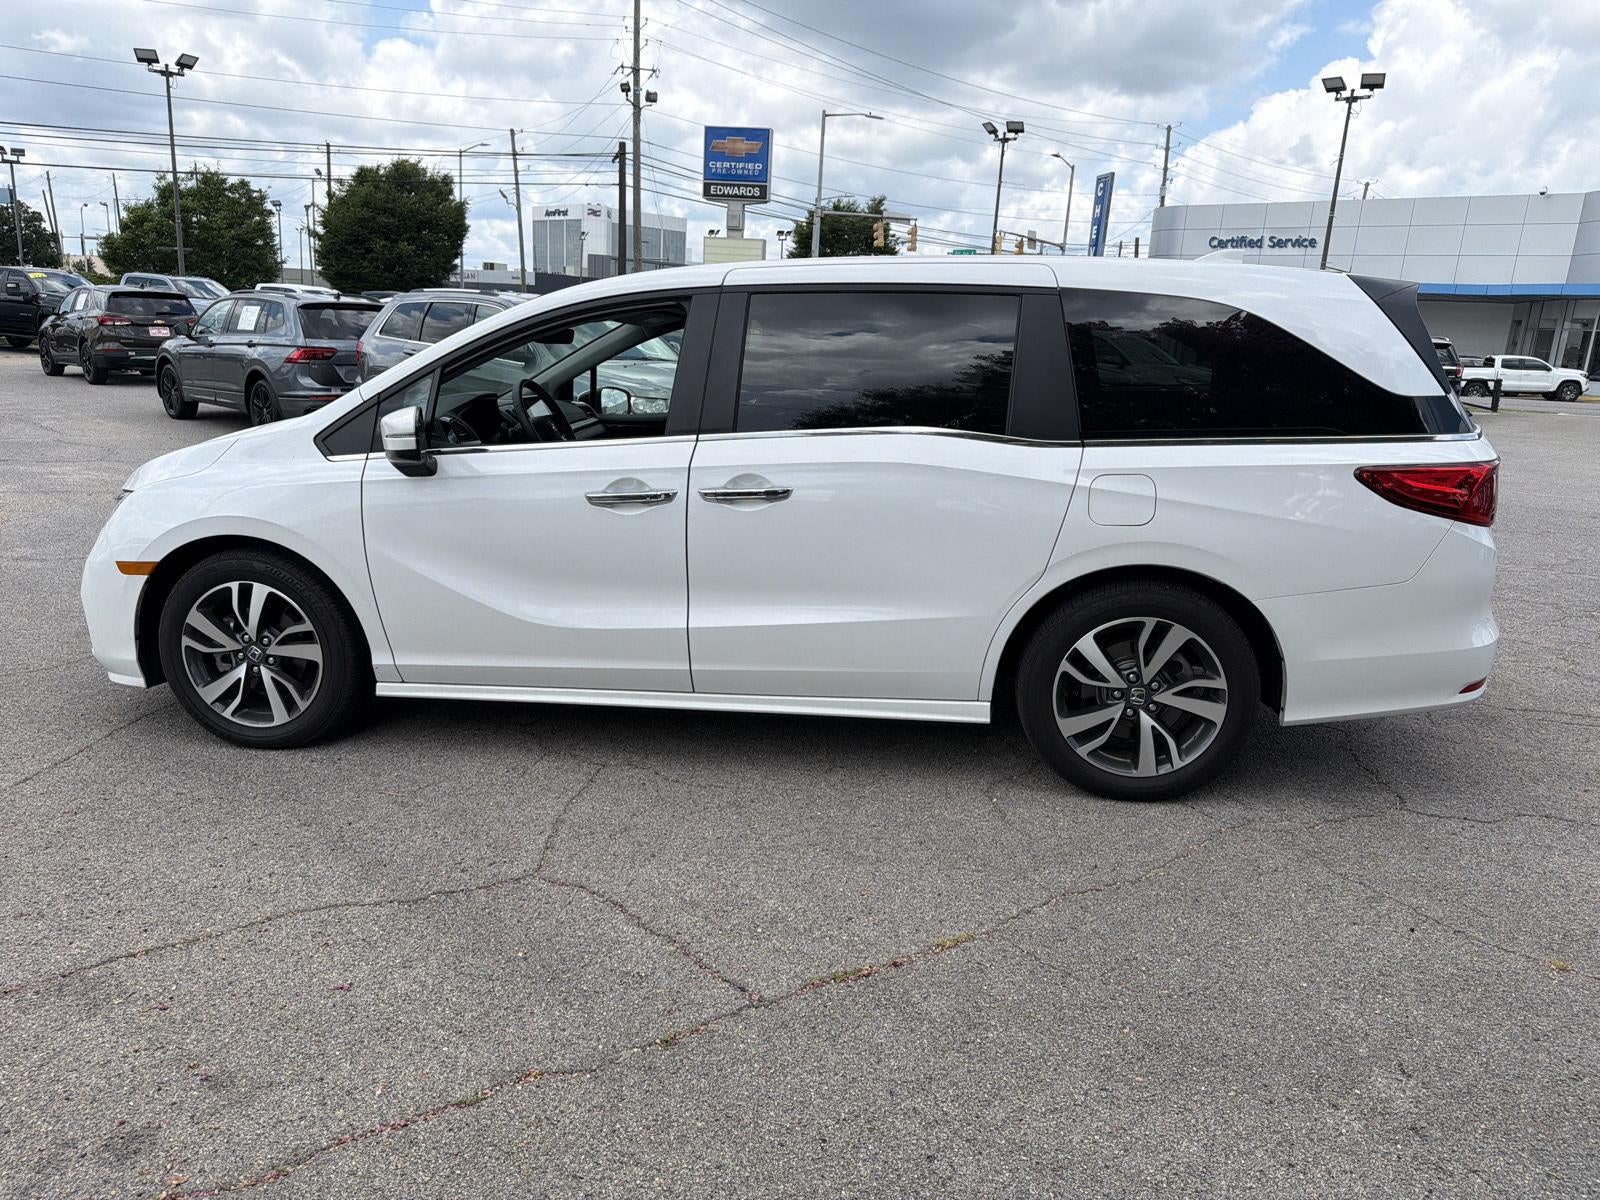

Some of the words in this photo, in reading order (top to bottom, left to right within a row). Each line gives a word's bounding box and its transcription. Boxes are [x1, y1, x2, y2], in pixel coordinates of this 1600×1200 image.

[709, 161, 763, 170] CERTIFIED
[711, 168, 760, 176] PRE-OWNED
[710, 185, 760, 197] EDWARDS
[1208, 235, 1264, 249] Certified
[1267, 235, 1317, 249] Service
